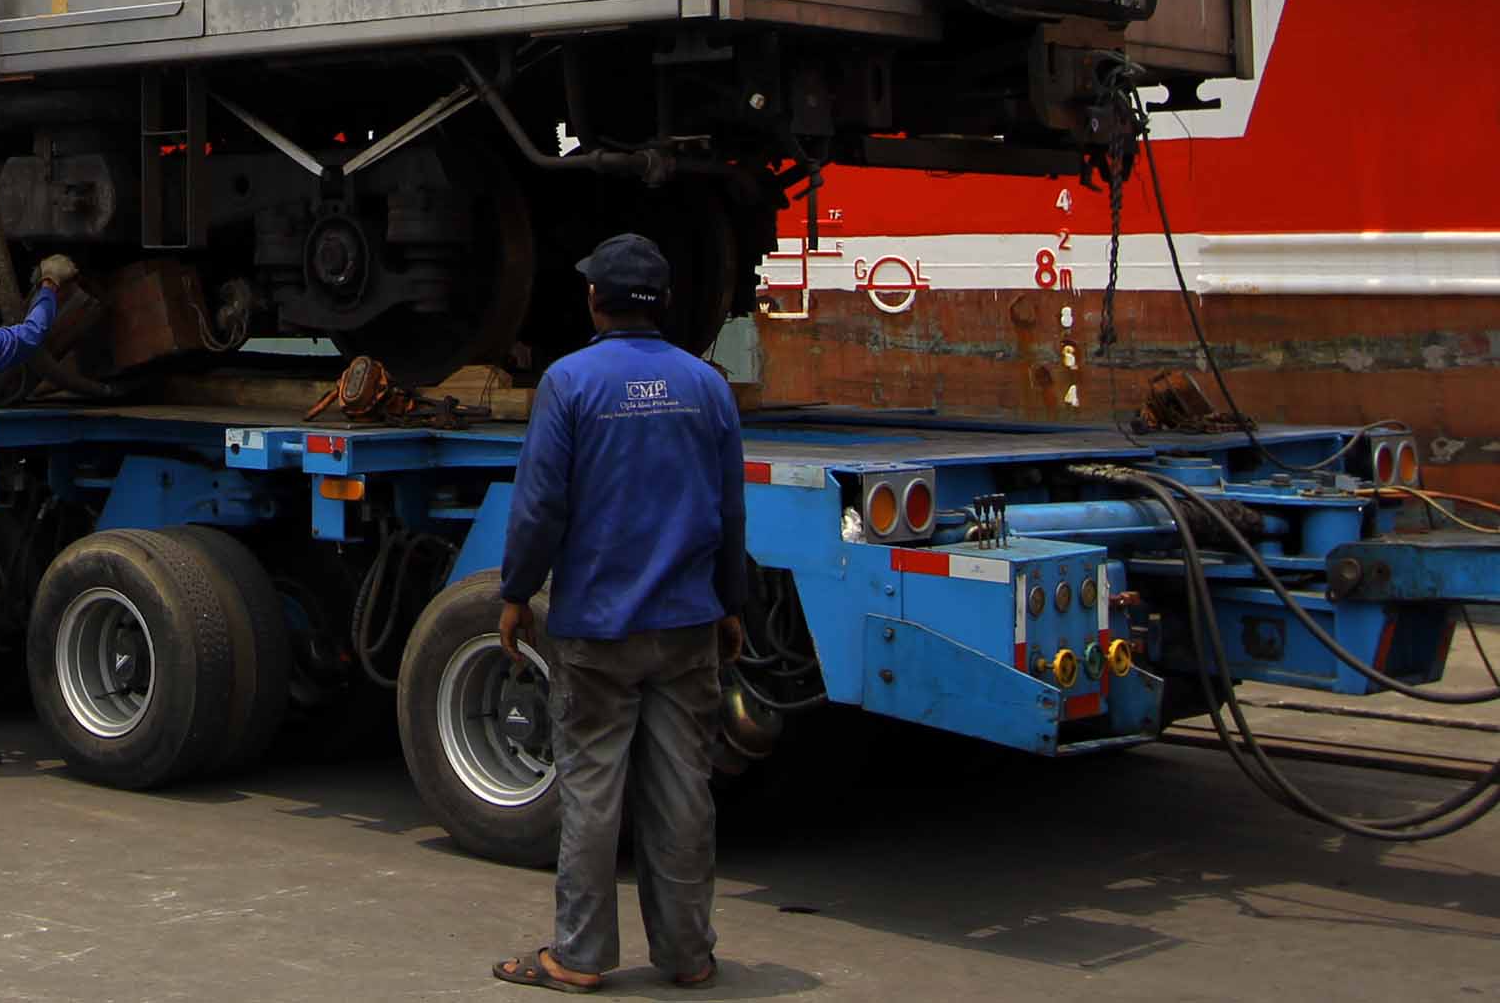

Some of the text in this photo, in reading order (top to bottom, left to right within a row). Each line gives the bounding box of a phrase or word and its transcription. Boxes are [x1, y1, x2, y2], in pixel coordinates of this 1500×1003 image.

[1056, 188, 1073, 213] 4
[1059, 228, 1072, 251] 2
[854, 256, 931, 282] G L
[628, 381, 665, 398] CMP
[1063, 384, 1080, 407] 4
